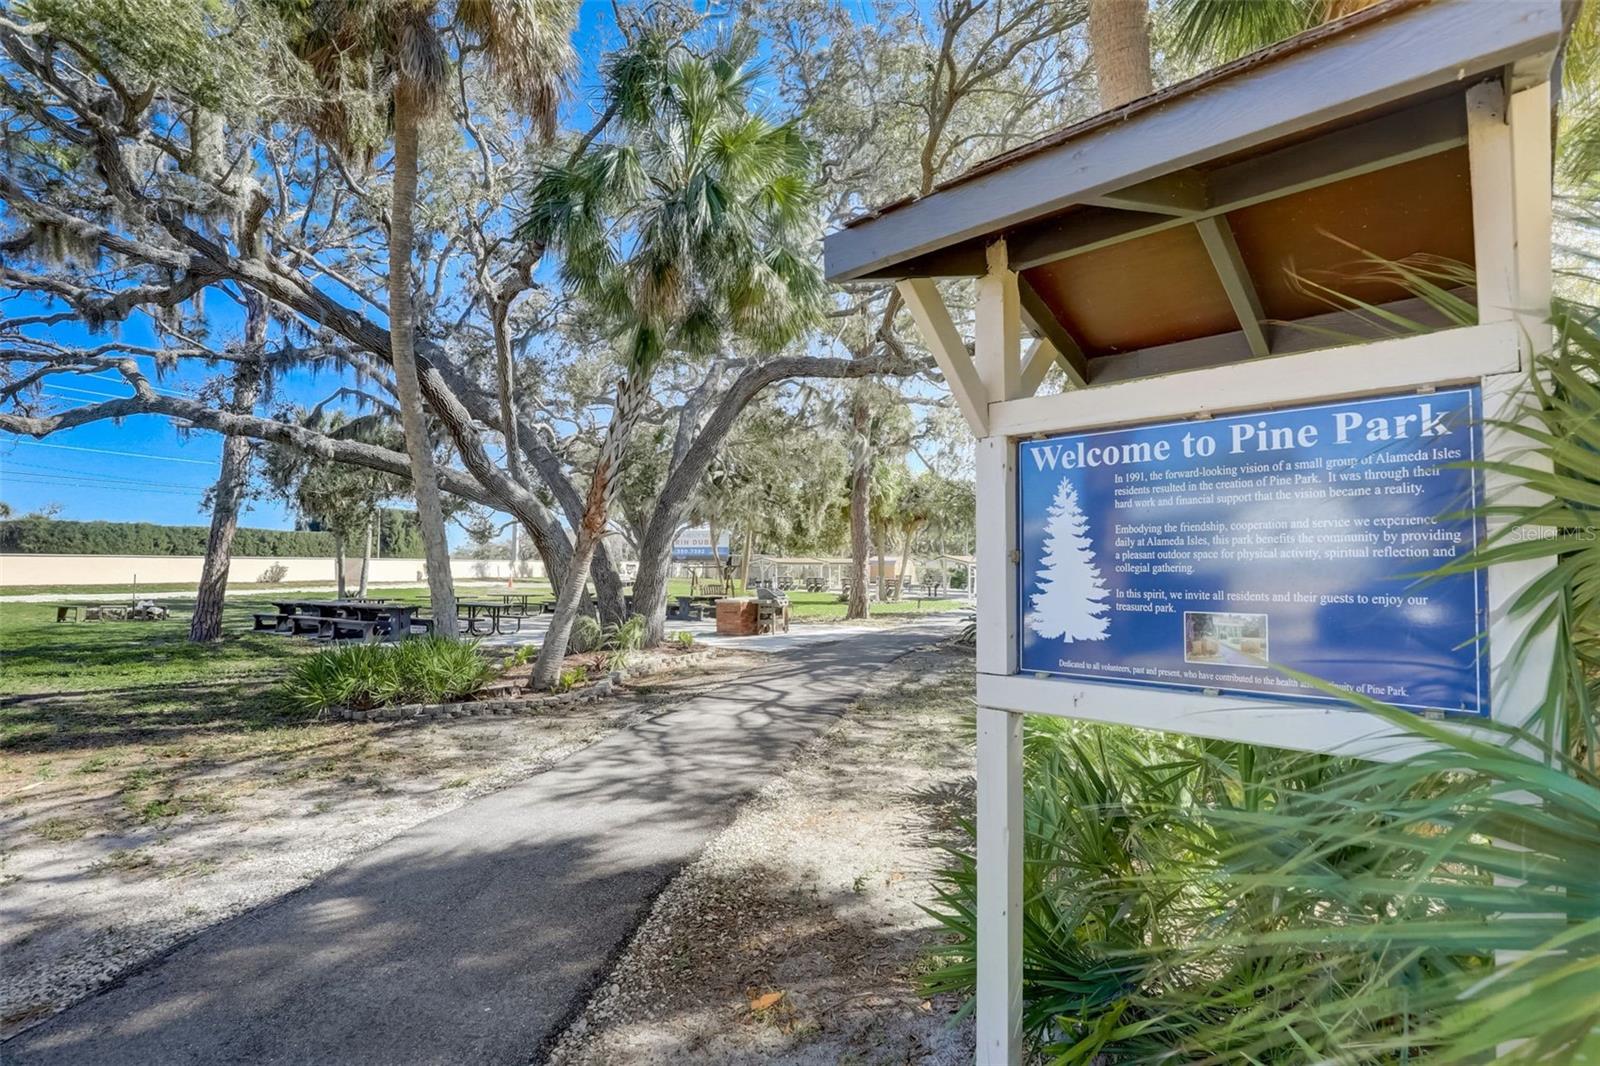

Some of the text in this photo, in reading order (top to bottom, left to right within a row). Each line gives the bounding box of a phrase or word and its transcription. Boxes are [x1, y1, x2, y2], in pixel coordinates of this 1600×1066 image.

[1030, 403, 1452, 472] Welcome to Pine Park
[1114, 474, 1122, 484] In
[1126, 472, 1147, 483] 1991,
[1150, 471, 1162, 481] the
[1165, 465, 1236, 480] forward-looking
[1240, 463, 1268, 474] vision
[1272, 461, 1282, 472] of
[1294, 458, 1321, 470] small
[1325, 458, 1355, 470] group
[1361, 454, 1375, 465] of
[1376, 450, 1428, 464] Alameda
[1432, 448, 1460, 459] Isles
[1114, 466, 1440, 495] residents resulted in the creation of Pine Park. It was through their
[1114, 497, 1132, 508] hard
[1135, 496, 1154, 506] work
[1158, 495, 1172, 505] and
[1176, 493, 1213, 504] financial
[1217, 491, 1251, 505] support
[1255, 490, 1270, 500] that
[1275, 489, 1291, 500] the
[1294, 488, 1325, 498] vision
[1329, 486, 1370, 497] became
[1384, 482, 1424, 496] reality.
[1115, 523, 1161, 535] Embodying
[1164, 522, 1177, 532] the
[1180, 521, 1227, 533] friendship,
[1230, 519, 1288, 532] cooperation
[1291, 518, 1309, 528] and
[1312, 517, 1349, 528] service
[1115, 530, 1461, 548] daily at Alameda Isles, this park benefits the community by providing
[1122, 549, 1154, 561] pleasant
[1157, 549, 1190, 558] outdoor
[1193, 552, 1216, 561] space
[1220, 548, 1233, 558] for
[1236, 548, 1276, 561] physical
[1279, 548, 1321, 560] activity,
[1325, 547, 1368, 560] spiritual
[1372, 546, 1428, 557] reflection
[1432, 546, 1455, 557] and
[1115, 563, 1194, 575] collegial gathering.
[1115, 589, 1124, 598] In
[1126, 589, 1141, 598] this
[1142, 589, 1167, 601] spirit,
[1185, 590, 1210, 600] invite
[1212, 590, 1224, 600] all
[1226, 591, 1269, 601] residents
[1272, 592, 1290, 602] and
[1293, 592, 1317, 602] their
[1320, 593, 1353, 605] guests
[1357, 593, 1368, 603] to
[1371, 594, 1403, 607] enjoy
[1115, 601, 1176, 614] treasured park.
[1059, 659, 1085, 669] Dedicated
[1086, 661, 1090, 670] to
[1092, 662, 1100, 670] all
[1101, 663, 1131, 675] volunteers,
[1132, 666, 1144, 676] past
[1146, 667, 1156, 675] and
[1158, 669, 1180, 679] present,
[1183, 670, 1197, 679] who
[1198, 671, 1213, 680] have
[1215, 673, 1252, 683] contributed
[1256, 676, 1263, 684] to
[1266, 676, 1274, 685] the
[1276, 677, 1297, 687] health
[1356, 684, 1364, 693] of
[1367, 685, 1385, 694] Pine
[1388, 686, 1408, 696] Park.
